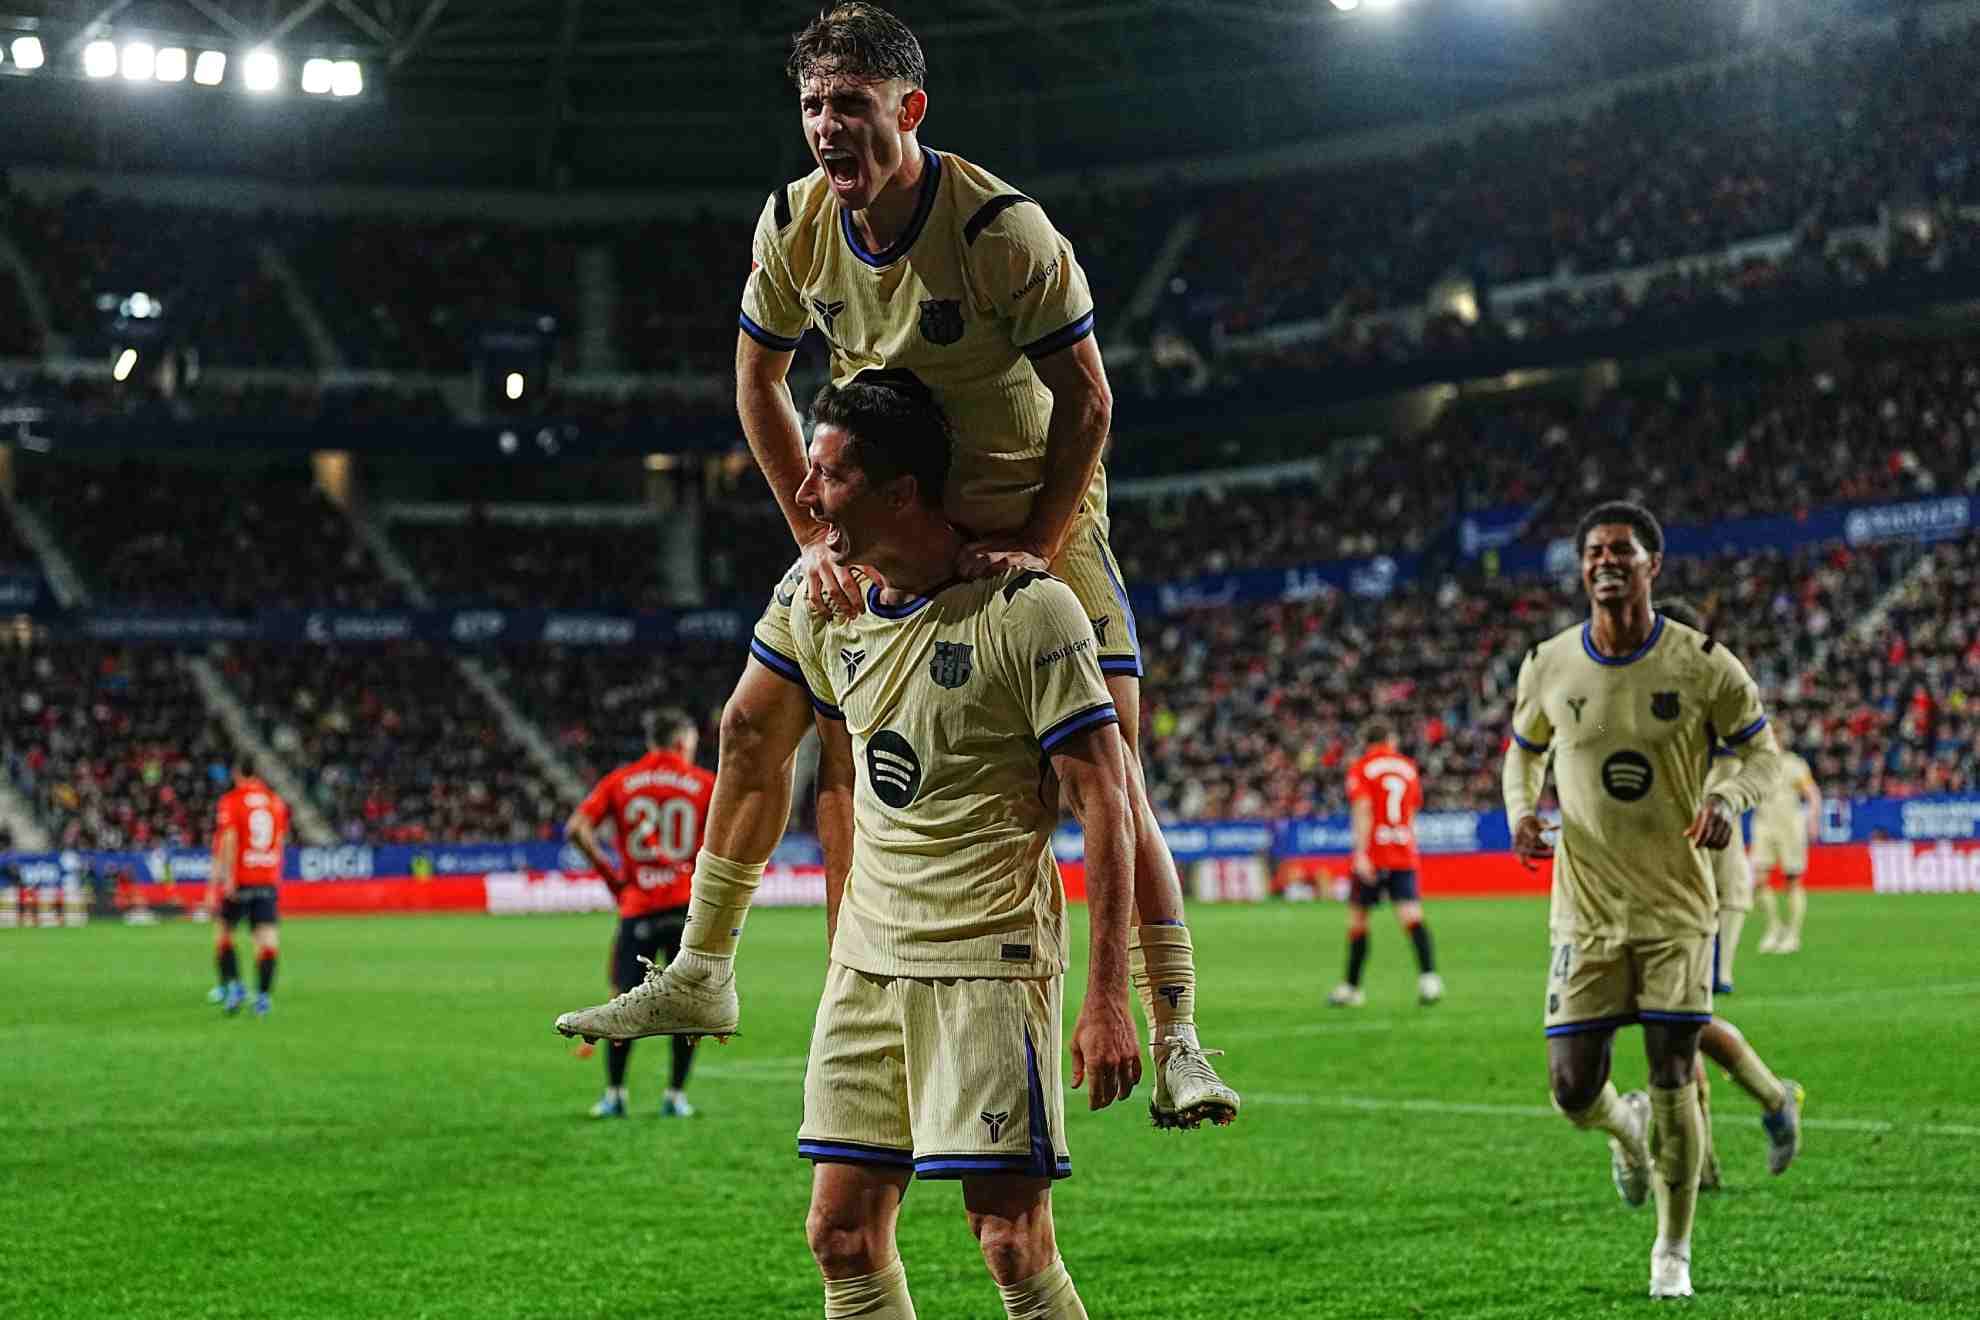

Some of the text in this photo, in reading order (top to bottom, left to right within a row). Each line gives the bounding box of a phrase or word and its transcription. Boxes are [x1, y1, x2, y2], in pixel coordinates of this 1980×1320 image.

[1381, 775, 1406, 825] 7
[249, 809, 274, 849] 9
[624, 795, 697, 863] 20
[299, 845, 374, 880] DIGI
